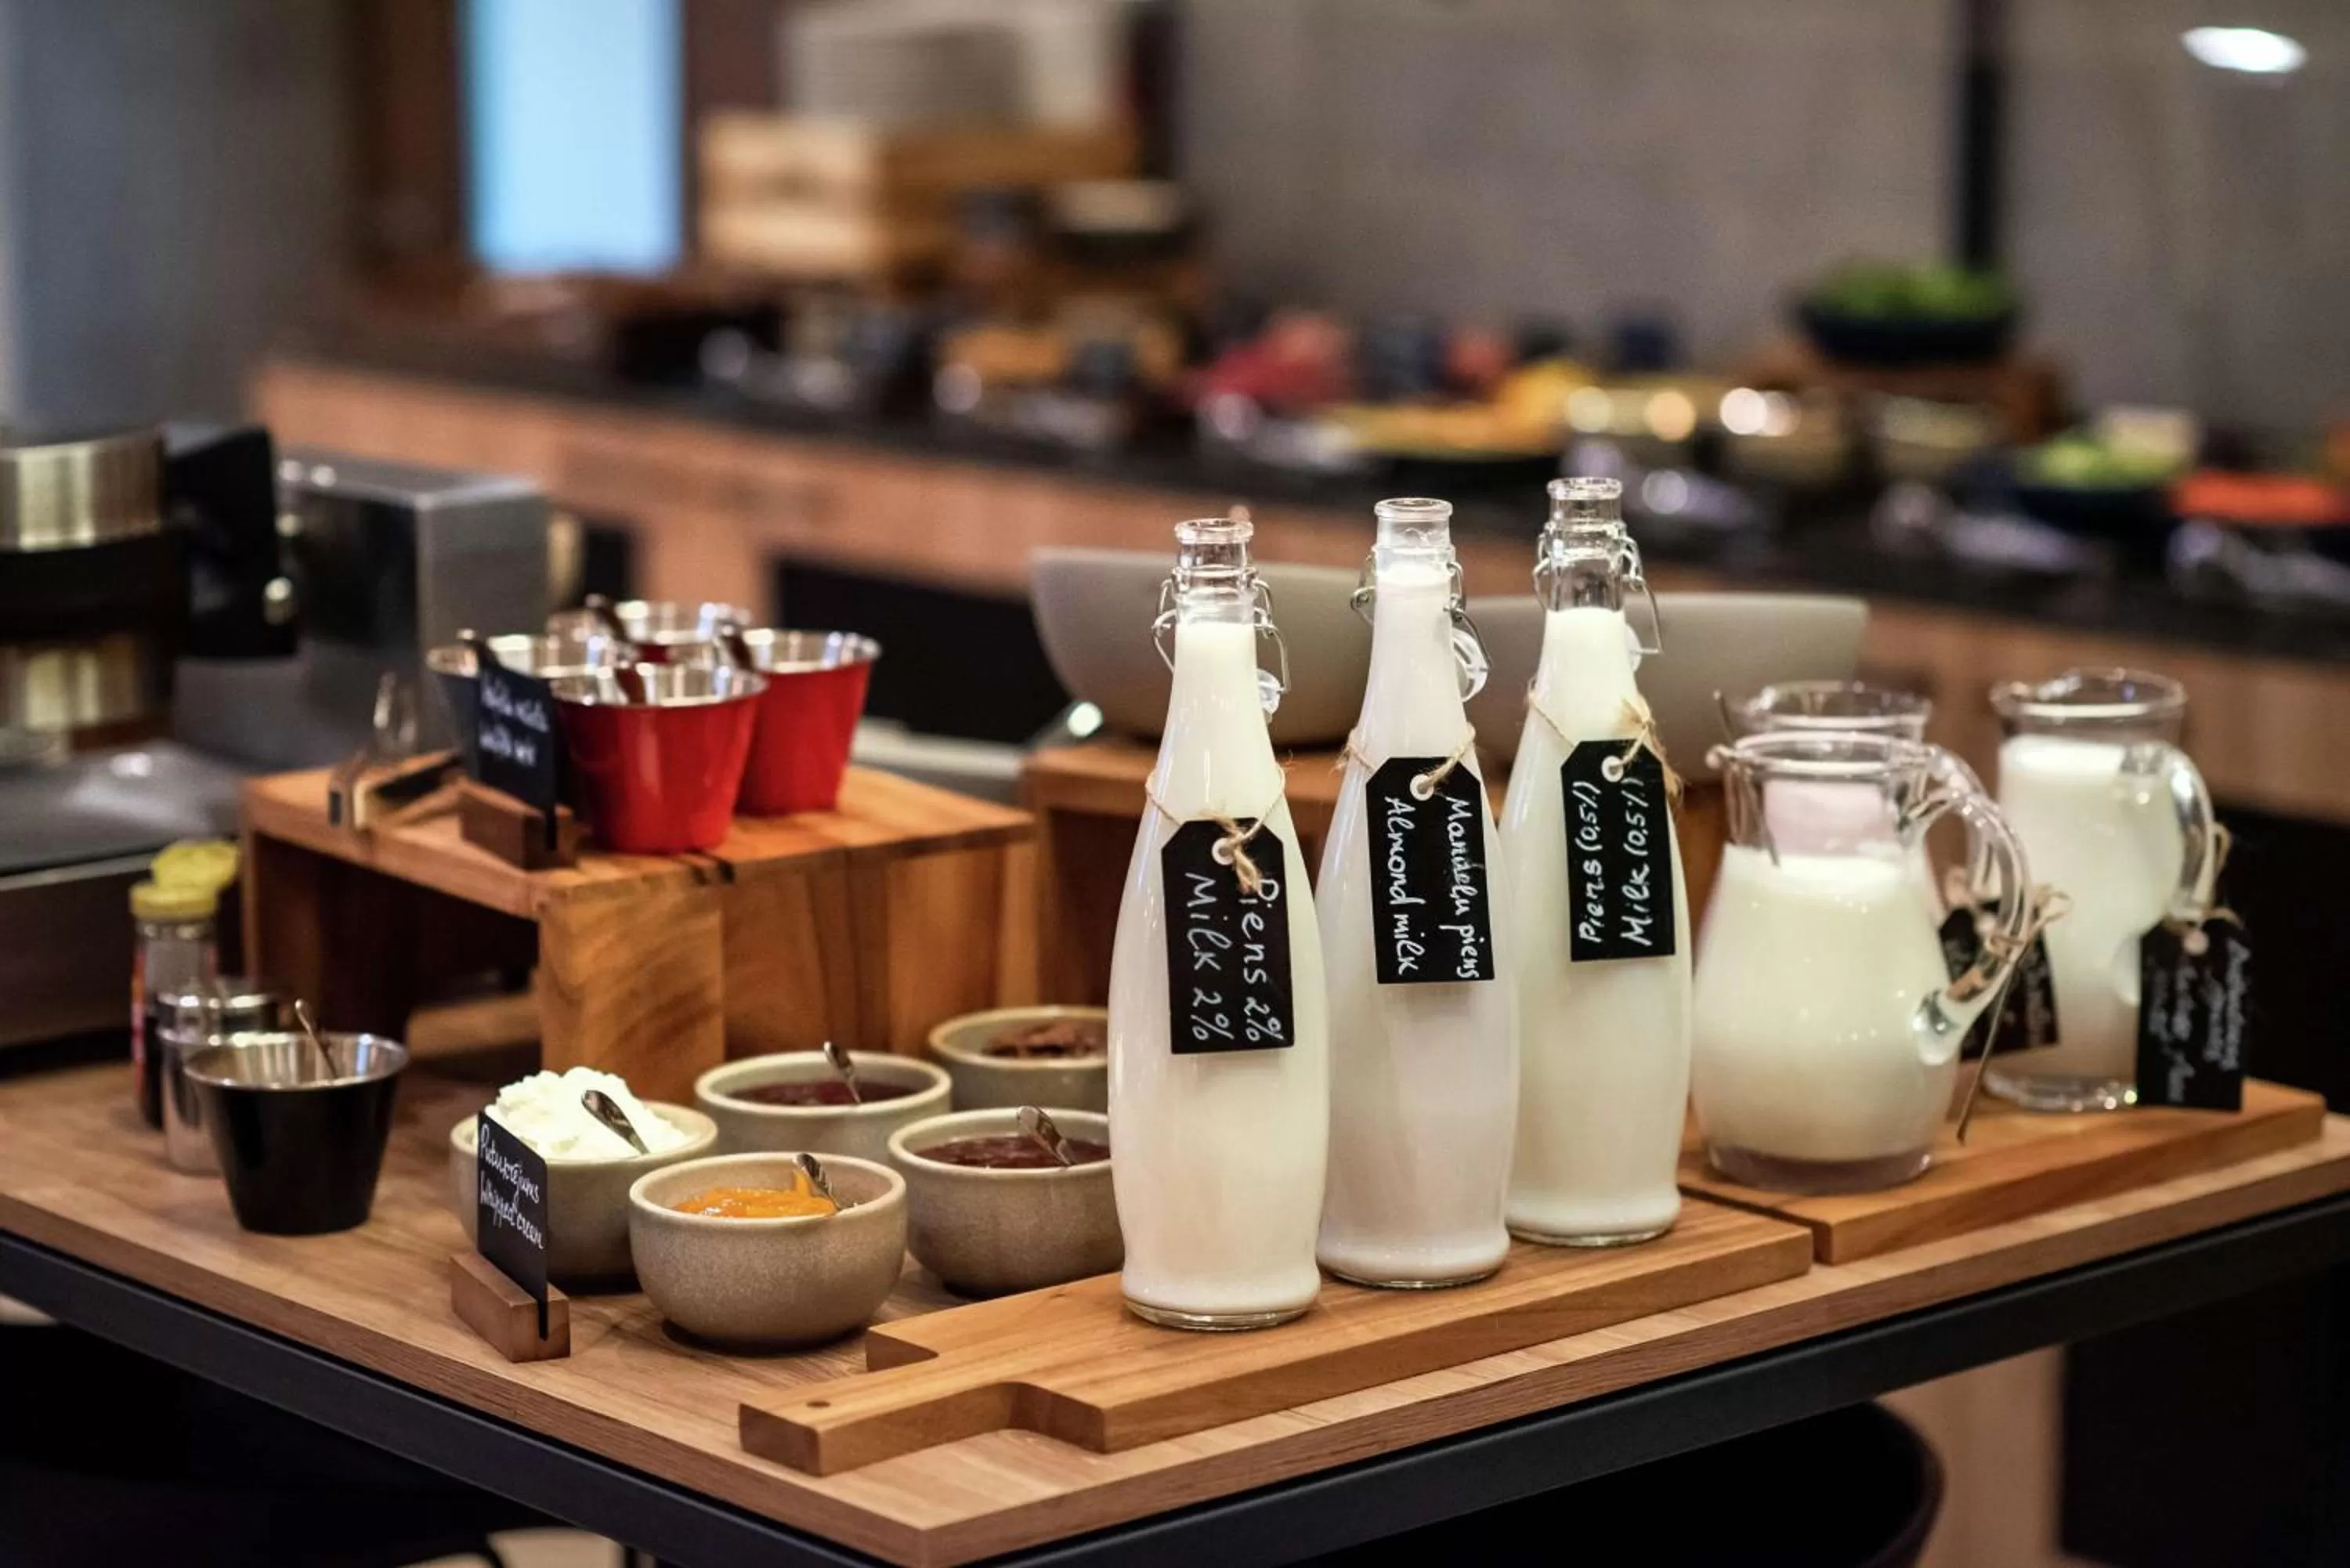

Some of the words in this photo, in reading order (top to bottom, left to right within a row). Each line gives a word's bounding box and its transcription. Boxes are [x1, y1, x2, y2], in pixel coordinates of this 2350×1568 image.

[1384, 796, 1426, 905] Almond
[1184, 872, 1232, 971] Milk
[1238, 878, 1279, 985] Piens
[1578, 859, 1605, 943] Piens
[1620, 863, 1653, 946] Milk
[1393, 913, 1426, 975] milk
[1438, 923, 1485, 979] piens
[1190, 987, 1235, 1041] 2%
[1243, 996, 1284, 1042] 2%
